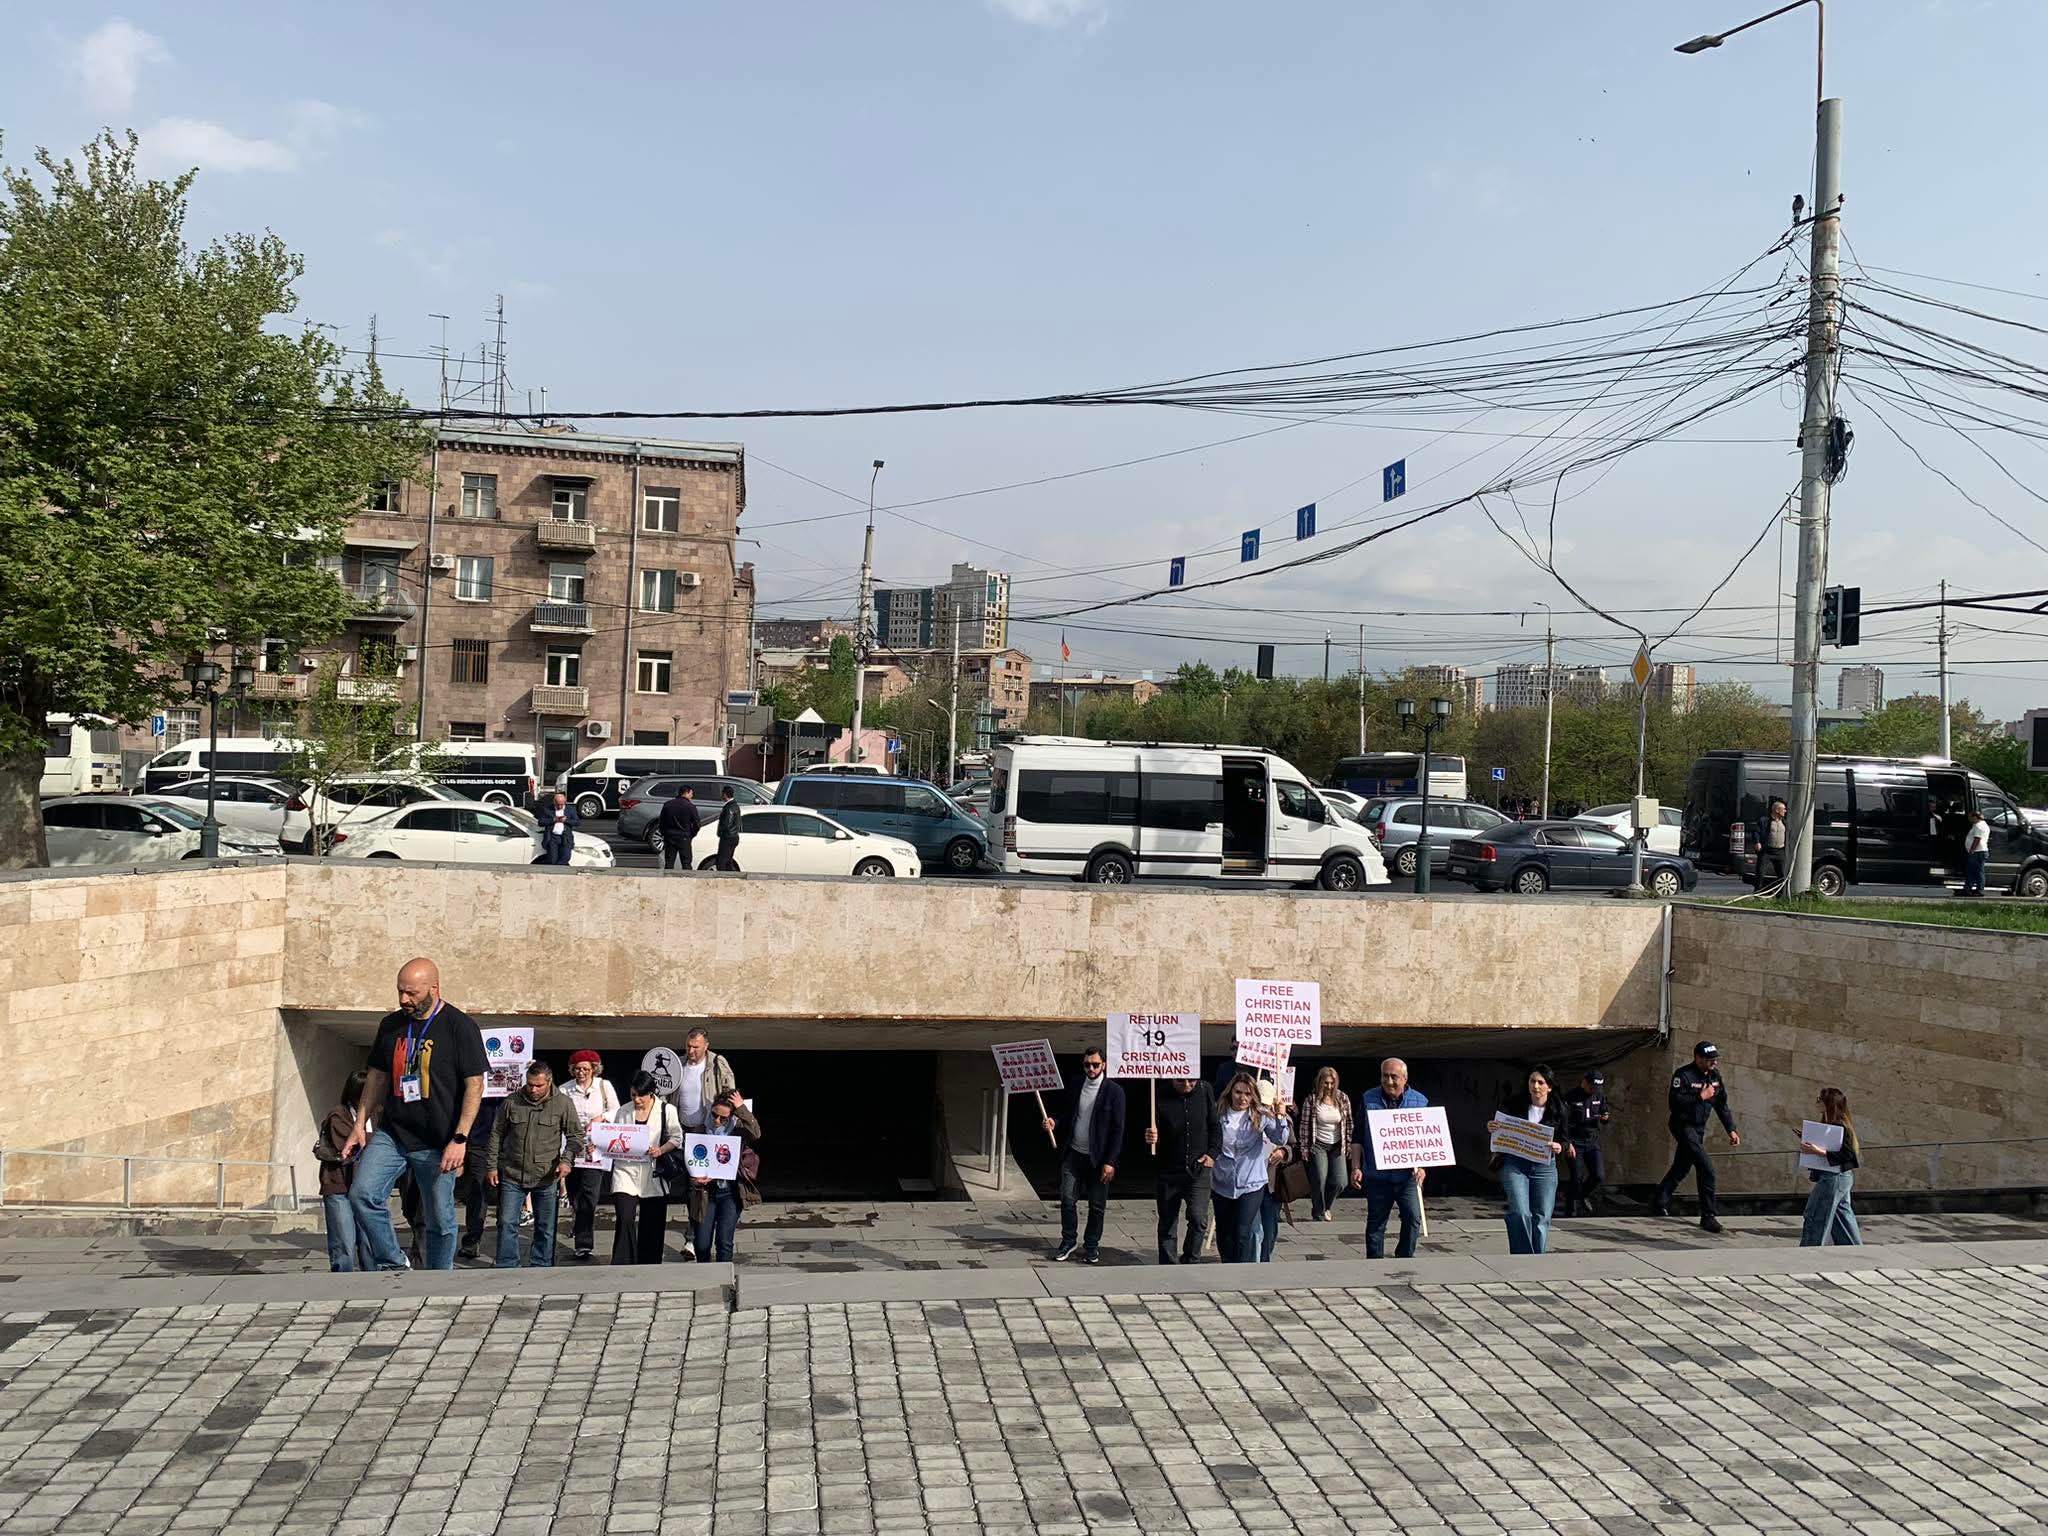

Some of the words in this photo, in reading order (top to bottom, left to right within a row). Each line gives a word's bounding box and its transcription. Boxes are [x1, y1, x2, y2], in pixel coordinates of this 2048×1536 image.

[1262, 985, 1294, 997] FREE
[1245, 998, 1311, 1011] CHRISTIAN
[1129, 1015, 1178, 1024] RETURN
[1245, 1012, 1311, 1025] ARMENIAN
[1143, 1030, 1166, 1046] 19
[1245, 1027, 1312, 1039] HOSTAGES
[1122, 1052, 1186, 1062] CRISTIANS
[1117, 1065, 1190, 1075] ARMENIANS
[1393, 1112, 1424, 1123] FREE
[1379, 1125, 1441, 1137] CHRISTIAN
[1382, 1138, 1444, 1151] ARMENIAN
[693, 1158, 710, 1167] YES
[1383, 1151, 1447, 1164] HOSTAGES
